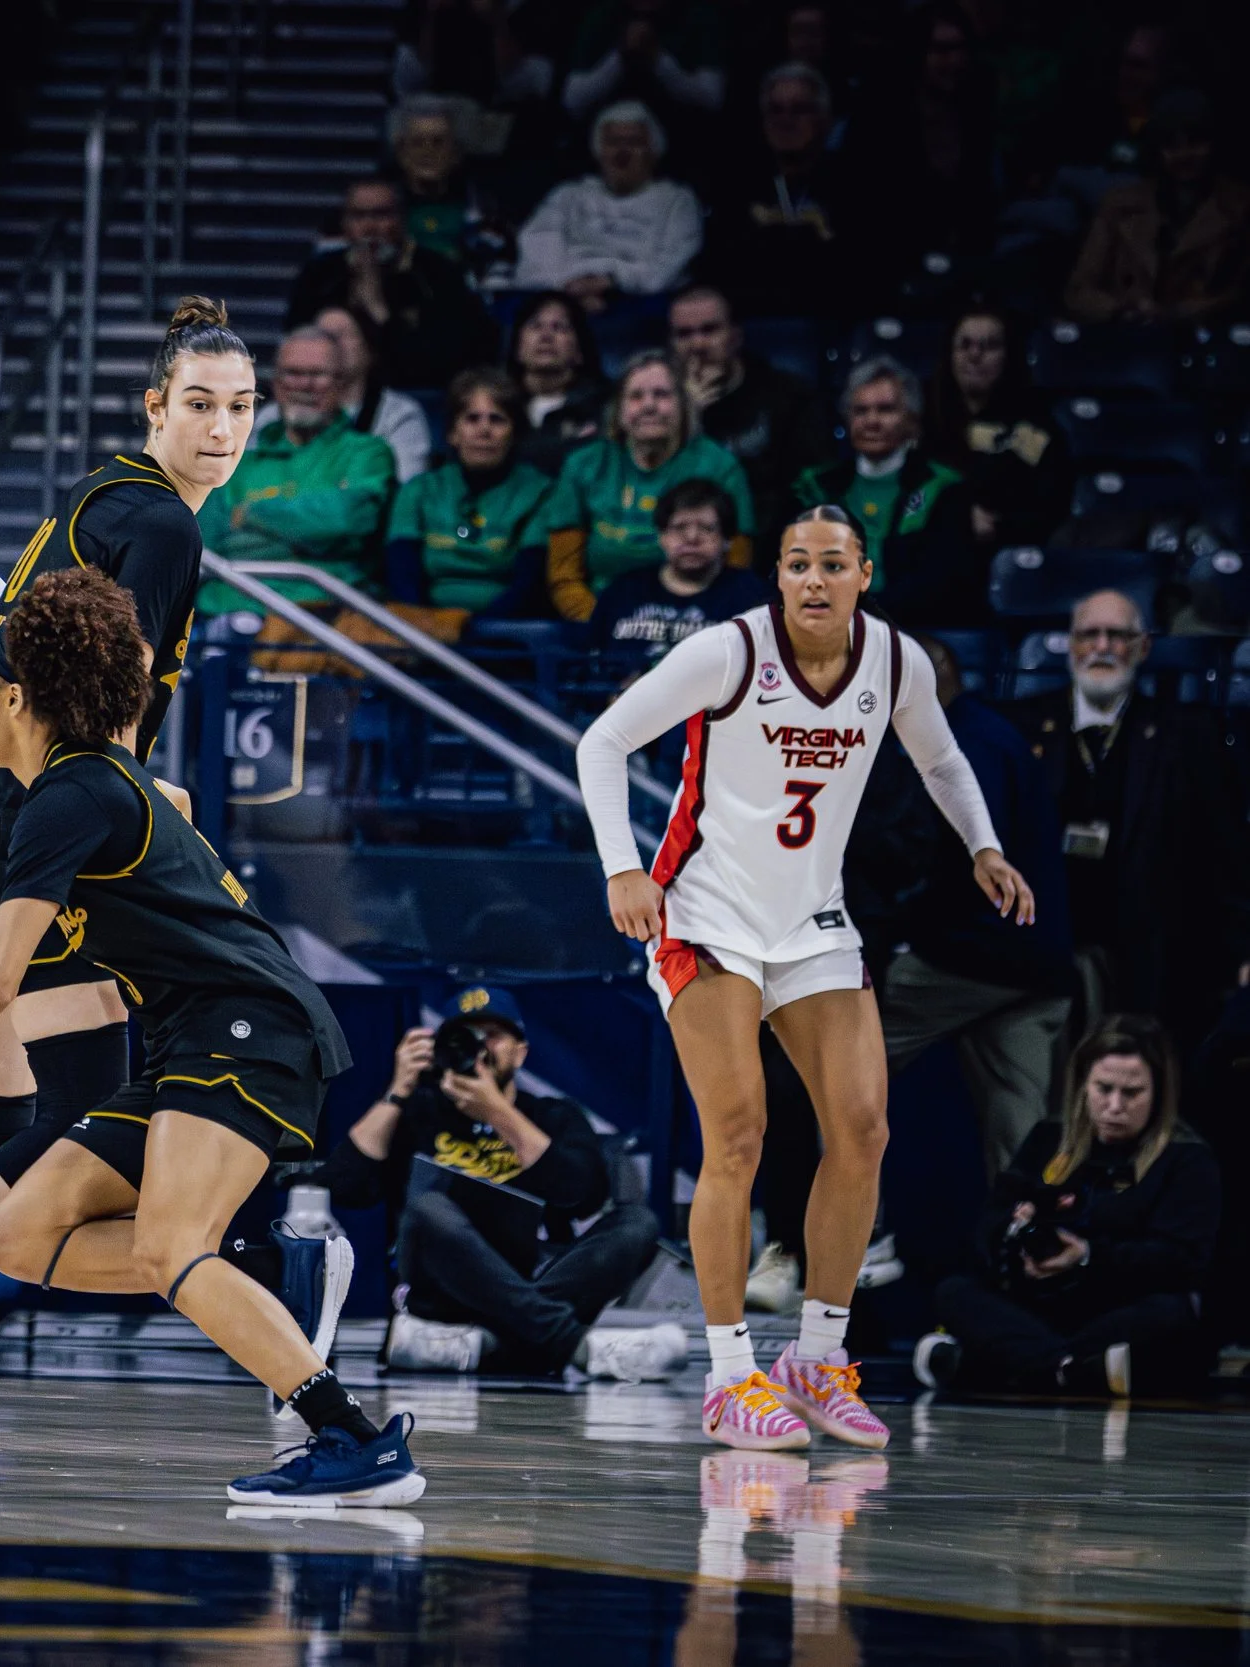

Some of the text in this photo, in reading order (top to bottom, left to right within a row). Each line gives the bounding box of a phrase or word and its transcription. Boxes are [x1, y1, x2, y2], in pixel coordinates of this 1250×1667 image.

[223, 706, 274, 759] 16
[760, 723, 866, 748] VIRGINIA
[781, 748, 848, 769] TECH
[776, 780, 827, 850] 3
